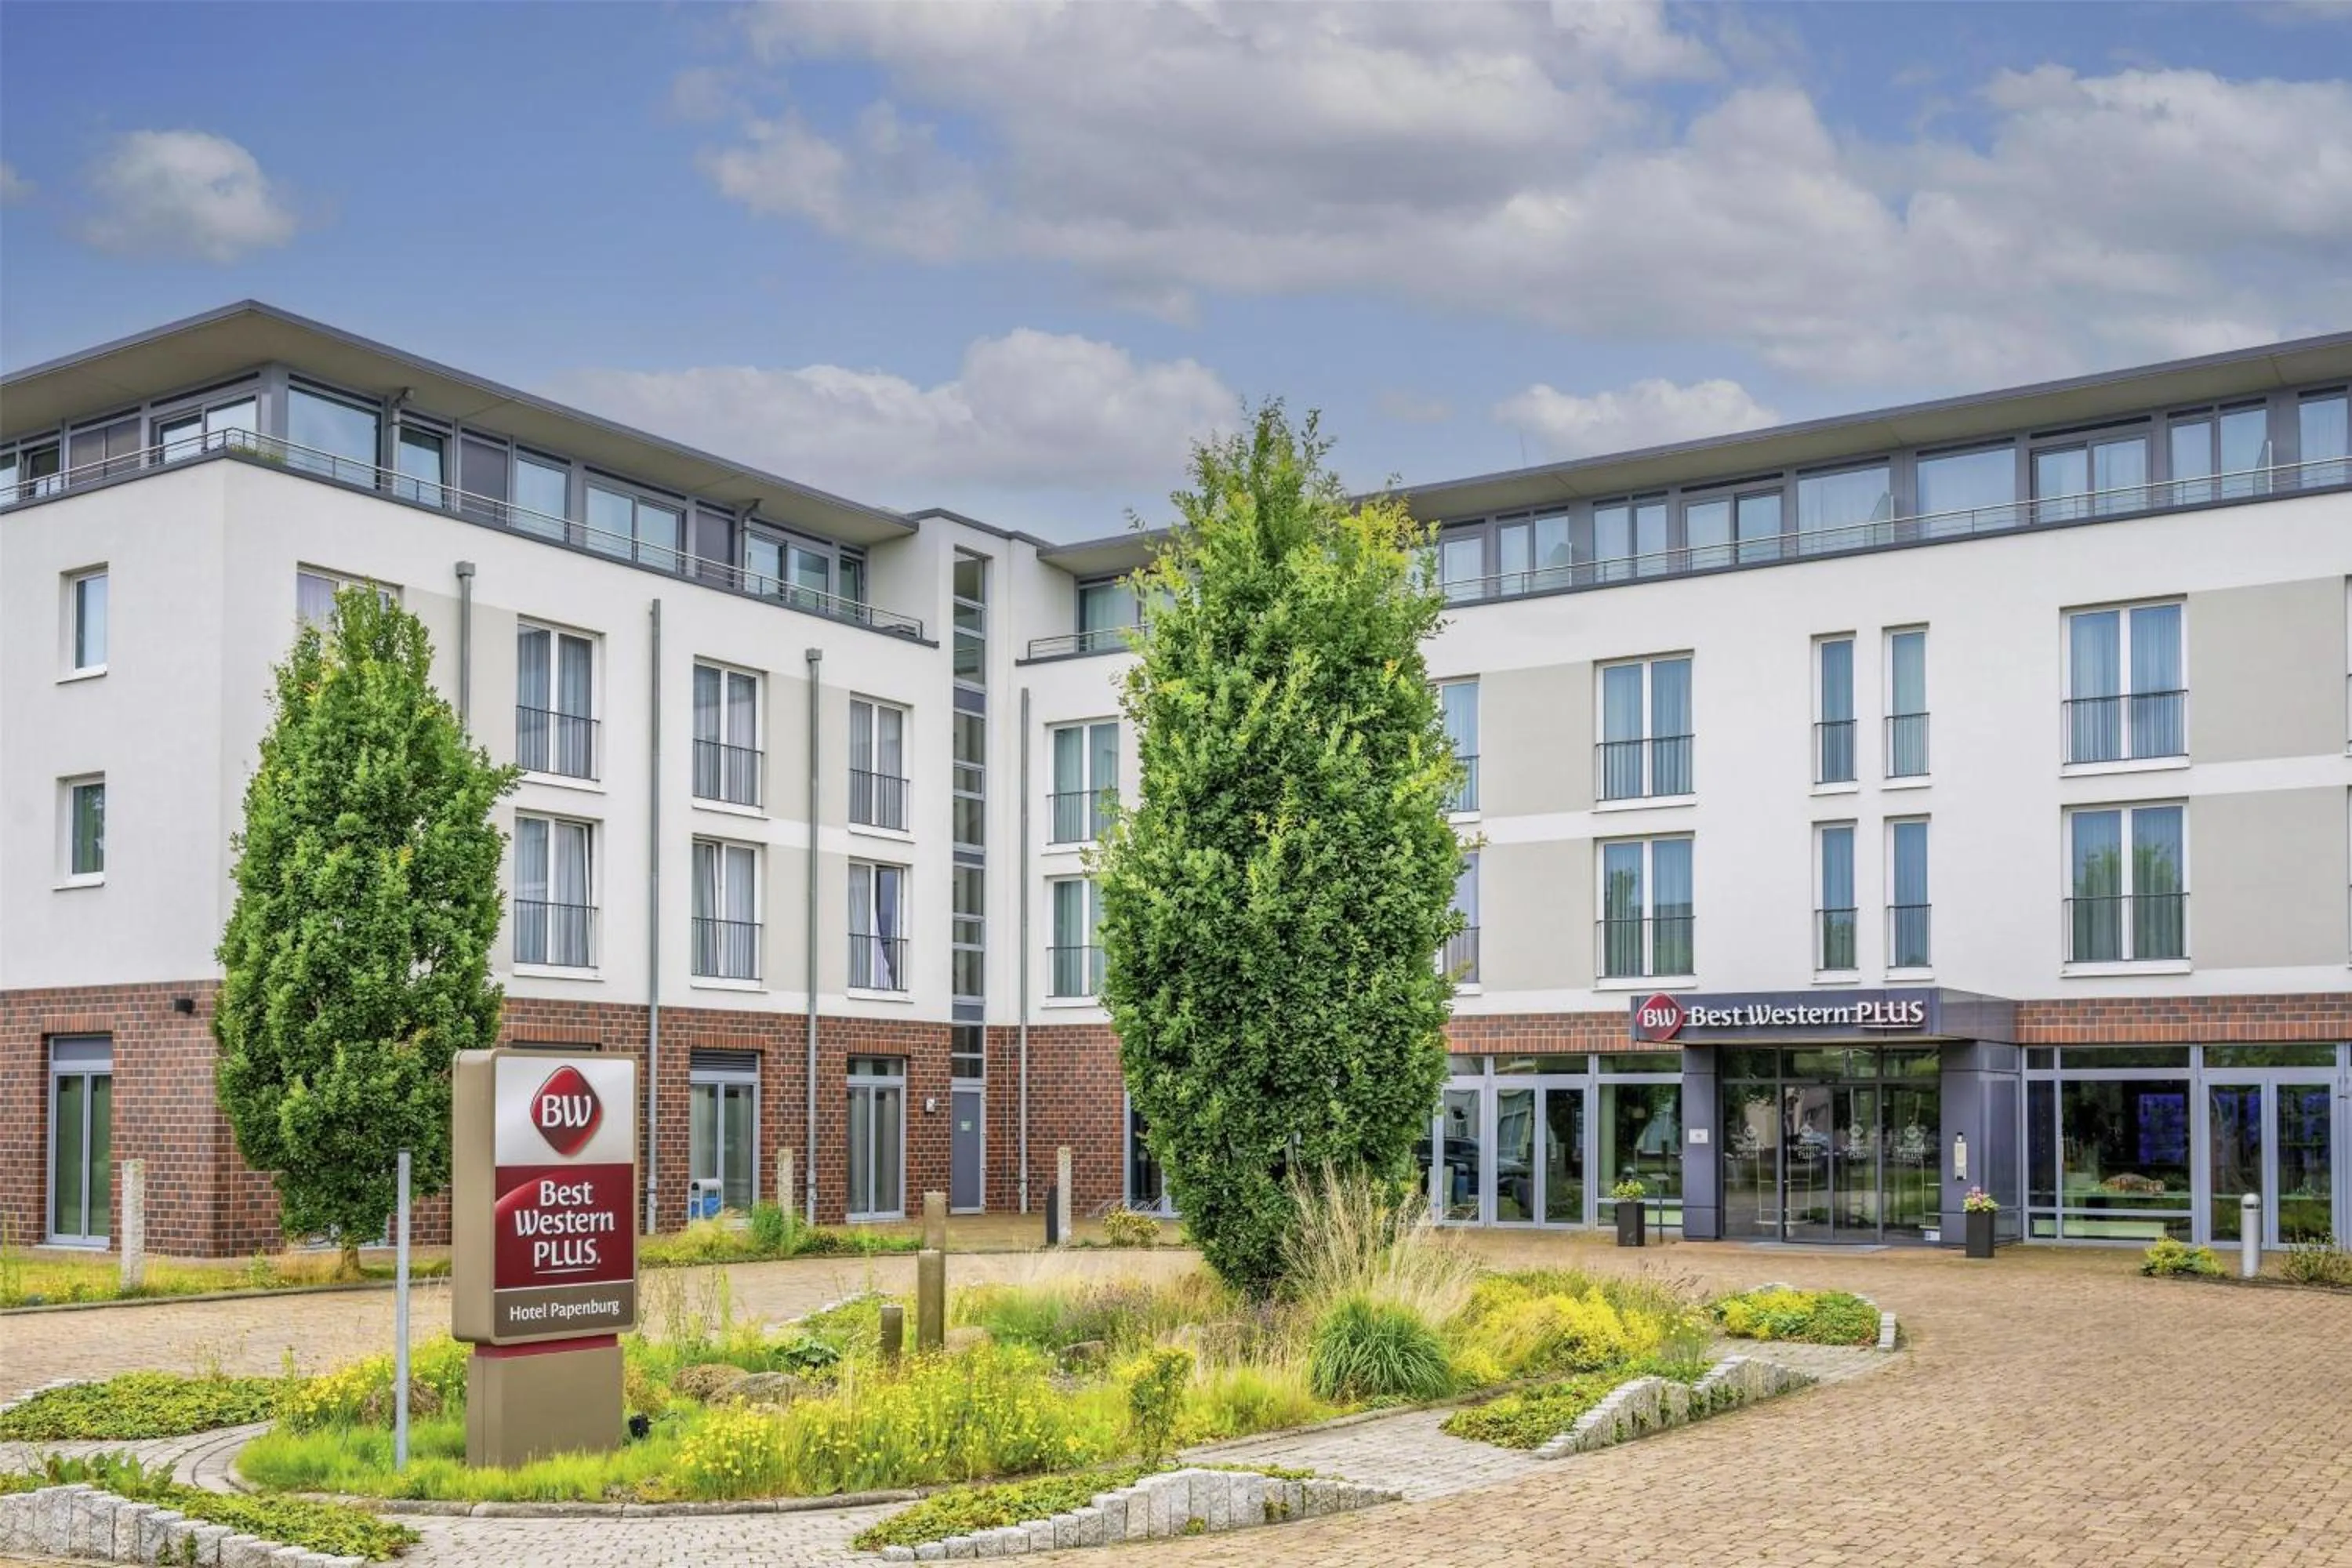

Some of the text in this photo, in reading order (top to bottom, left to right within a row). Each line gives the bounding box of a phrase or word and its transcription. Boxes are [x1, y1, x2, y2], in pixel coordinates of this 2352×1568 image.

[1643, 1008, 1677, 1027] BW
[1690, 1000, 1924, 1026] Best Western PLUS
[542, 1094, 592, 1127] BW
[540, 1180, 593, 1207] Best
[514, 1209, 615, 1236] Western
[510, 1298, 620, 1321] Hotel Papenburg
